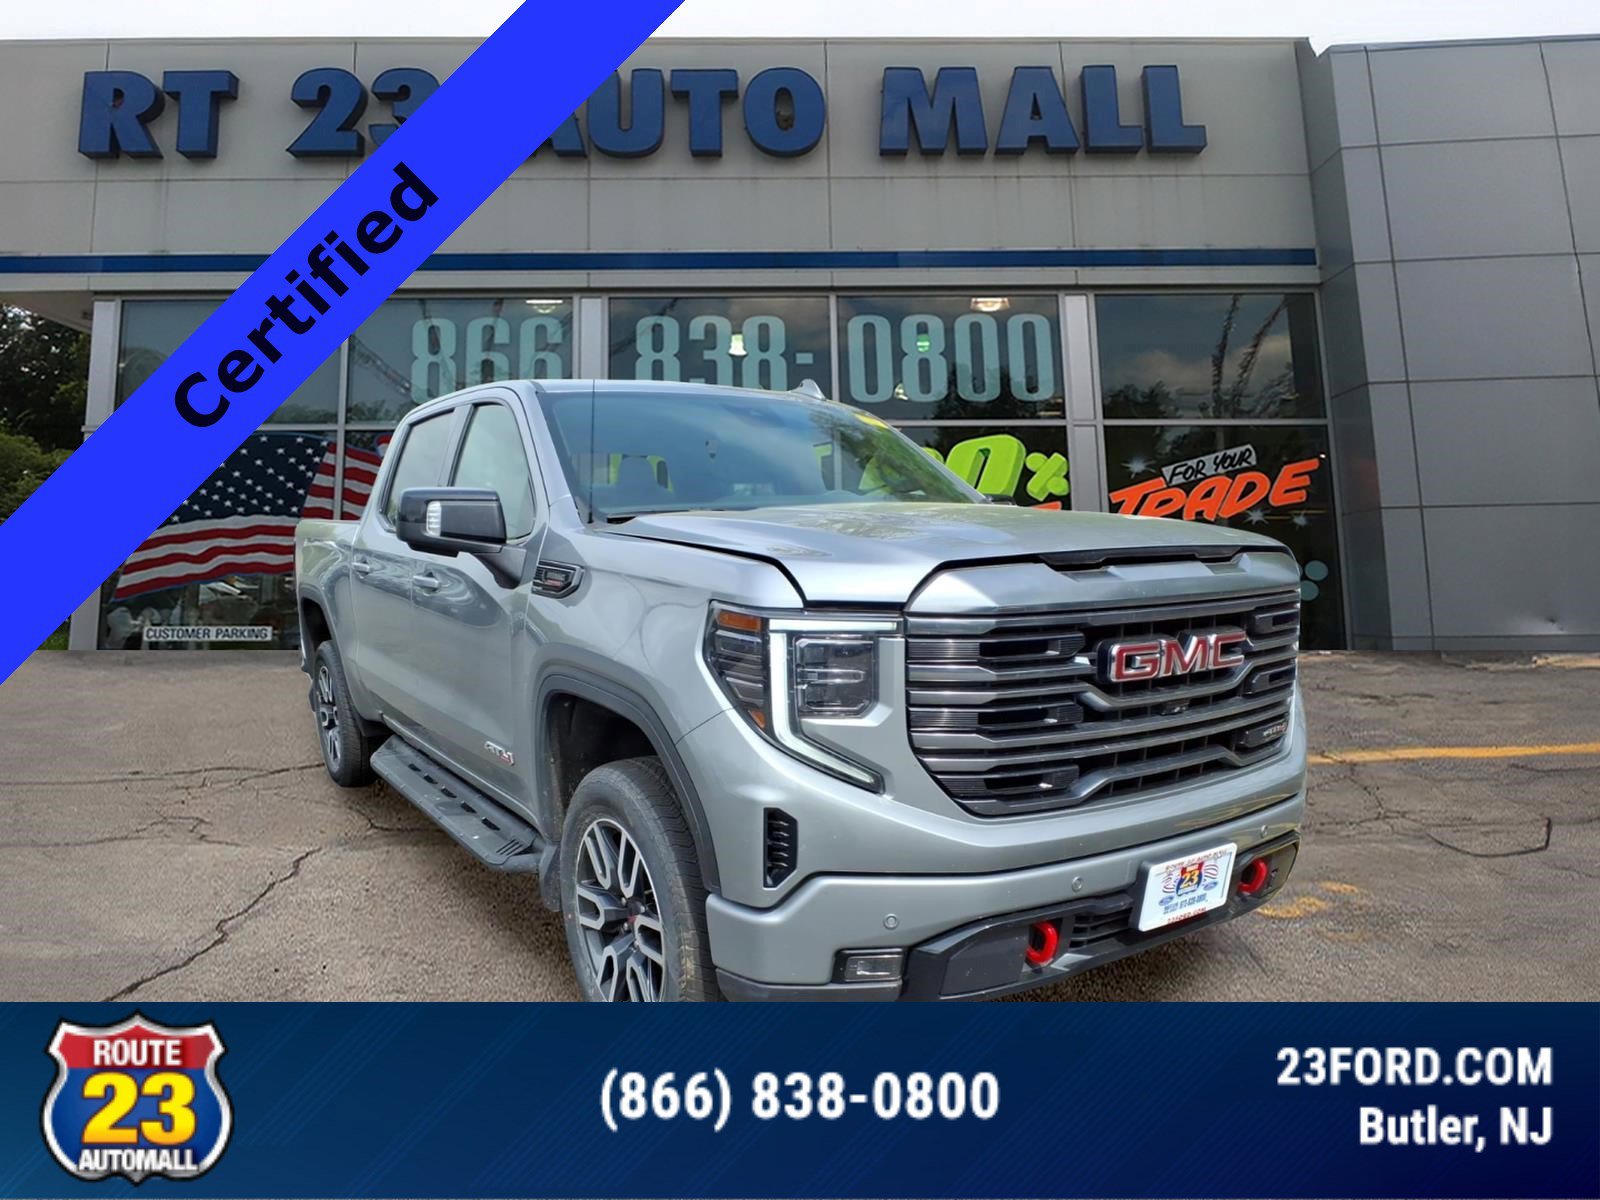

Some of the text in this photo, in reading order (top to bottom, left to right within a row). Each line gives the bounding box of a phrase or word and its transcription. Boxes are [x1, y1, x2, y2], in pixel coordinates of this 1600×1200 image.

[78, 70, 239, 159] RT
[880, 65, 1208, 156] MALL
[411, 317, 564, 405] 866
[1168, 448, 1252, 484] FOR YOUR
[145, 627, 269, 640] CUSTOMER PARKING
[1111, 630, 1247, 682] GMC
